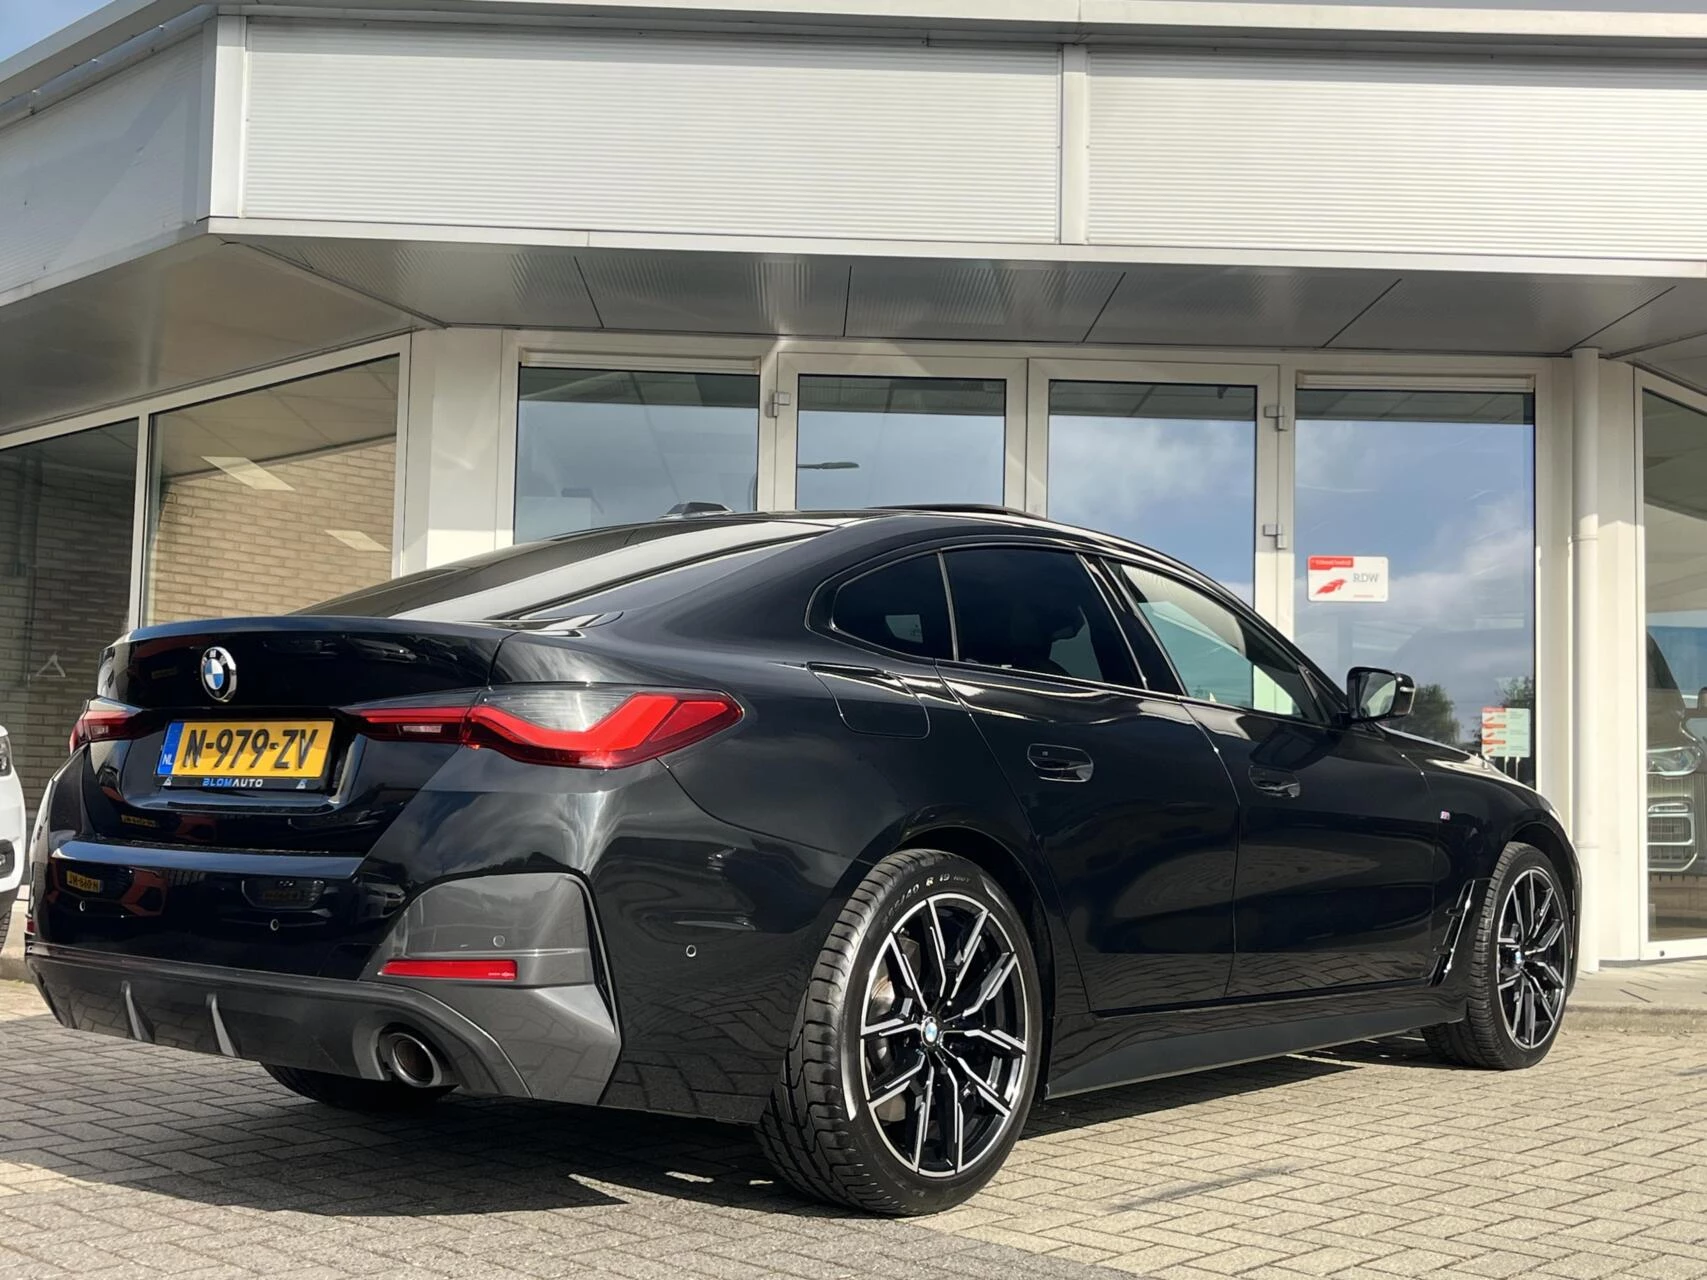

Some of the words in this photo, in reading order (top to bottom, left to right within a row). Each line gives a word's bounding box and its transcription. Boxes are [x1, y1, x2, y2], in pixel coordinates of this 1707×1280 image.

[1353, 572, 1379, 583] RDW
[182, 728, 319, 770] N-979-ZV
[161, 754, 173, 765] NL
[202, 777, 263, 788] BLOMAUTO
